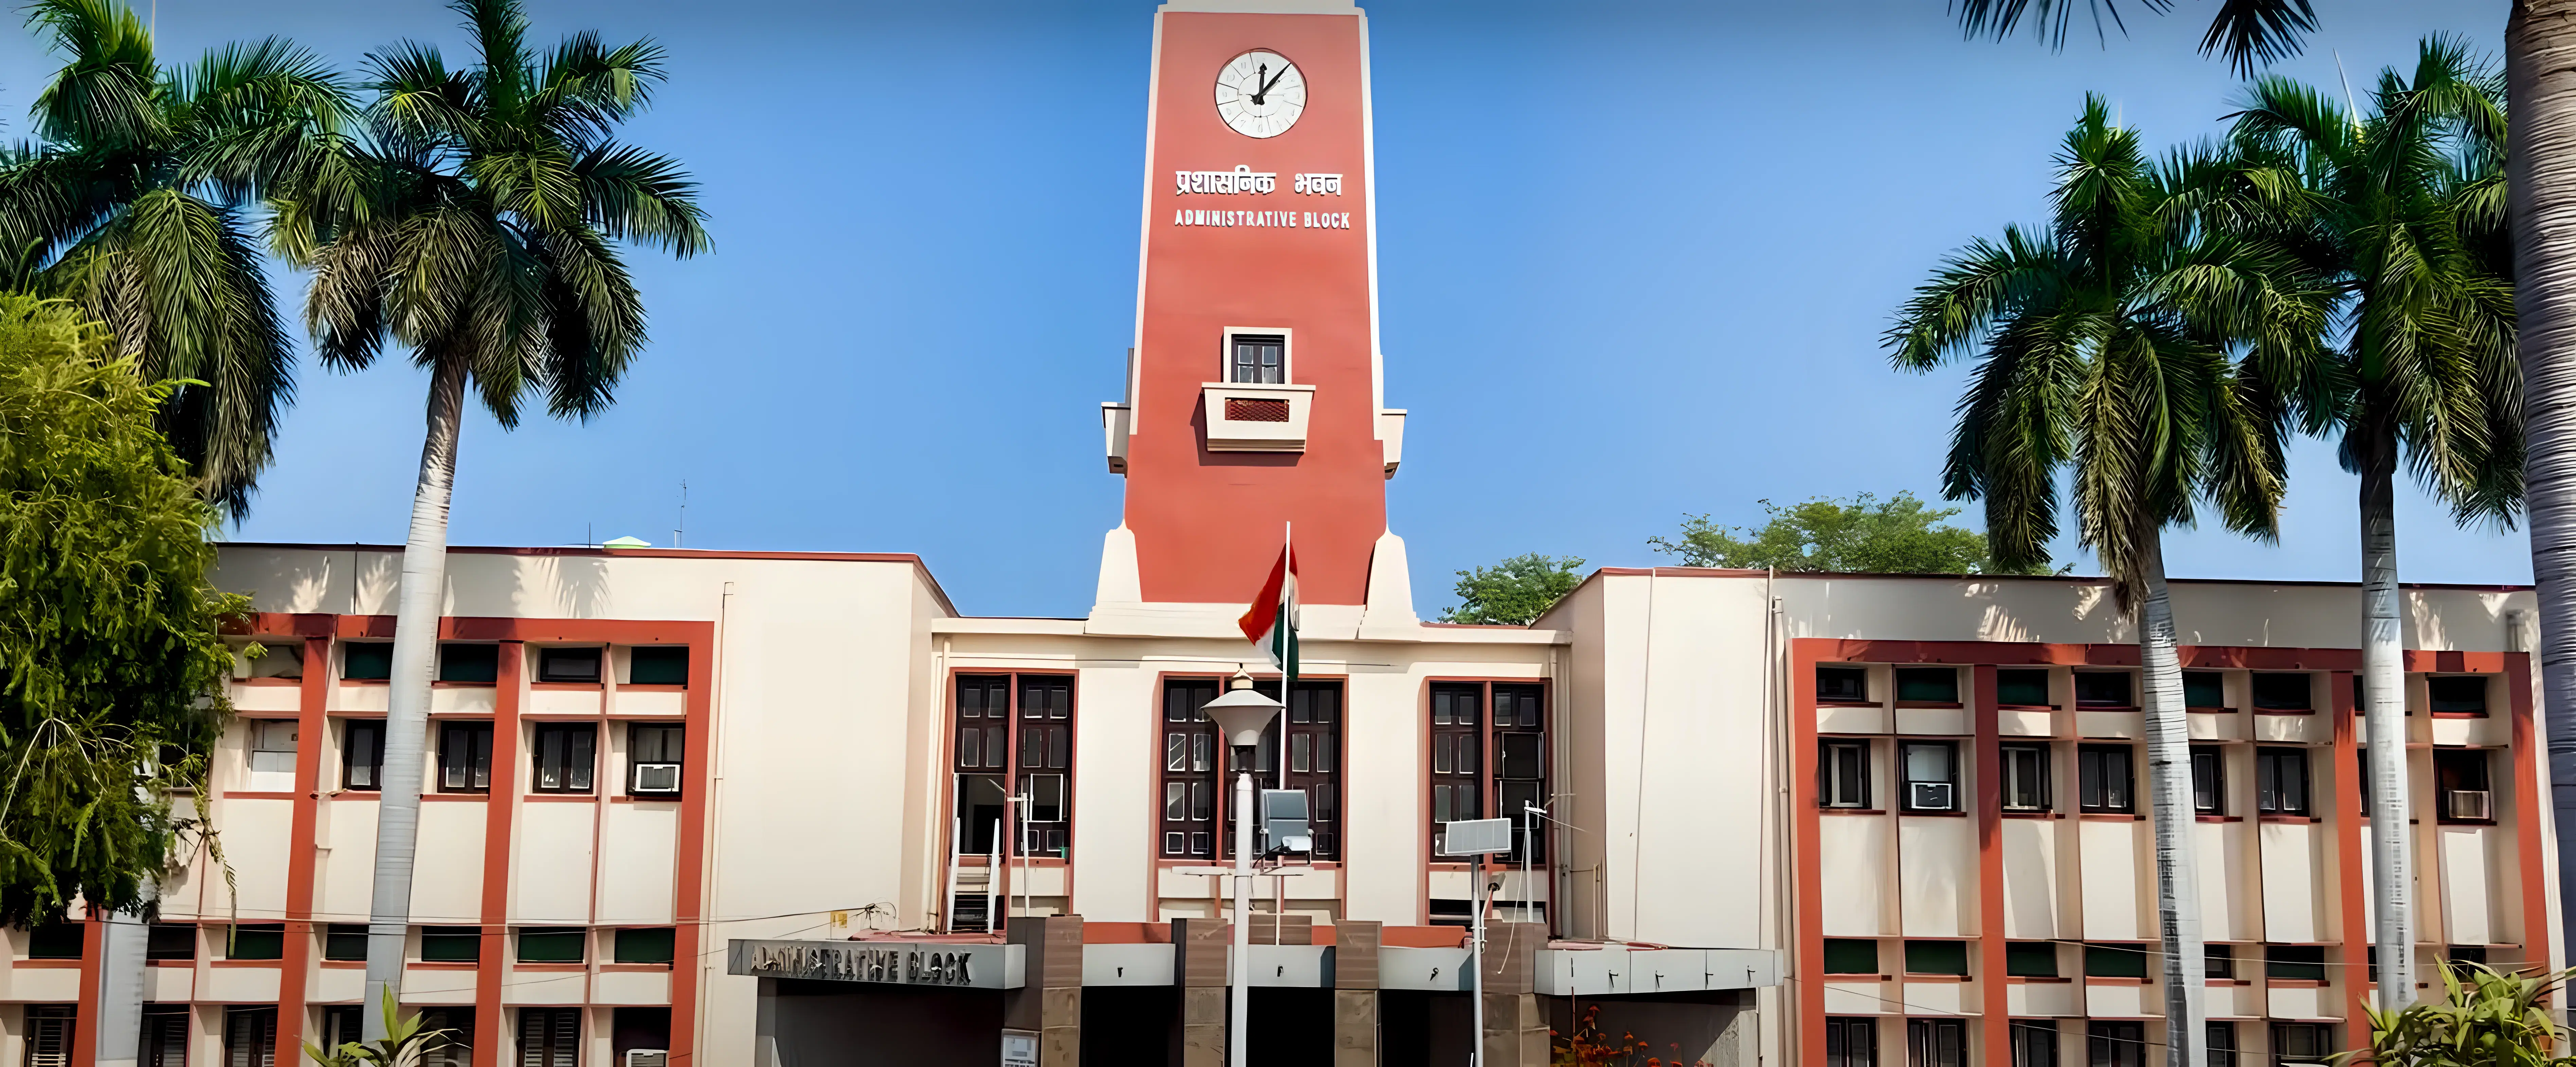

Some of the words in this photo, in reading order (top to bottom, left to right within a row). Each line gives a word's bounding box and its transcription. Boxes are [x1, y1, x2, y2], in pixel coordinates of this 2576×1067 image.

[1175, 164, 1277, 196] प्रशासनिक
[1294, 173, 1343, 196] भवन
[1174, 209, 1297, 227] ADMINISTRATIVE
[1304, 211, 1350, 230] BLOCK
